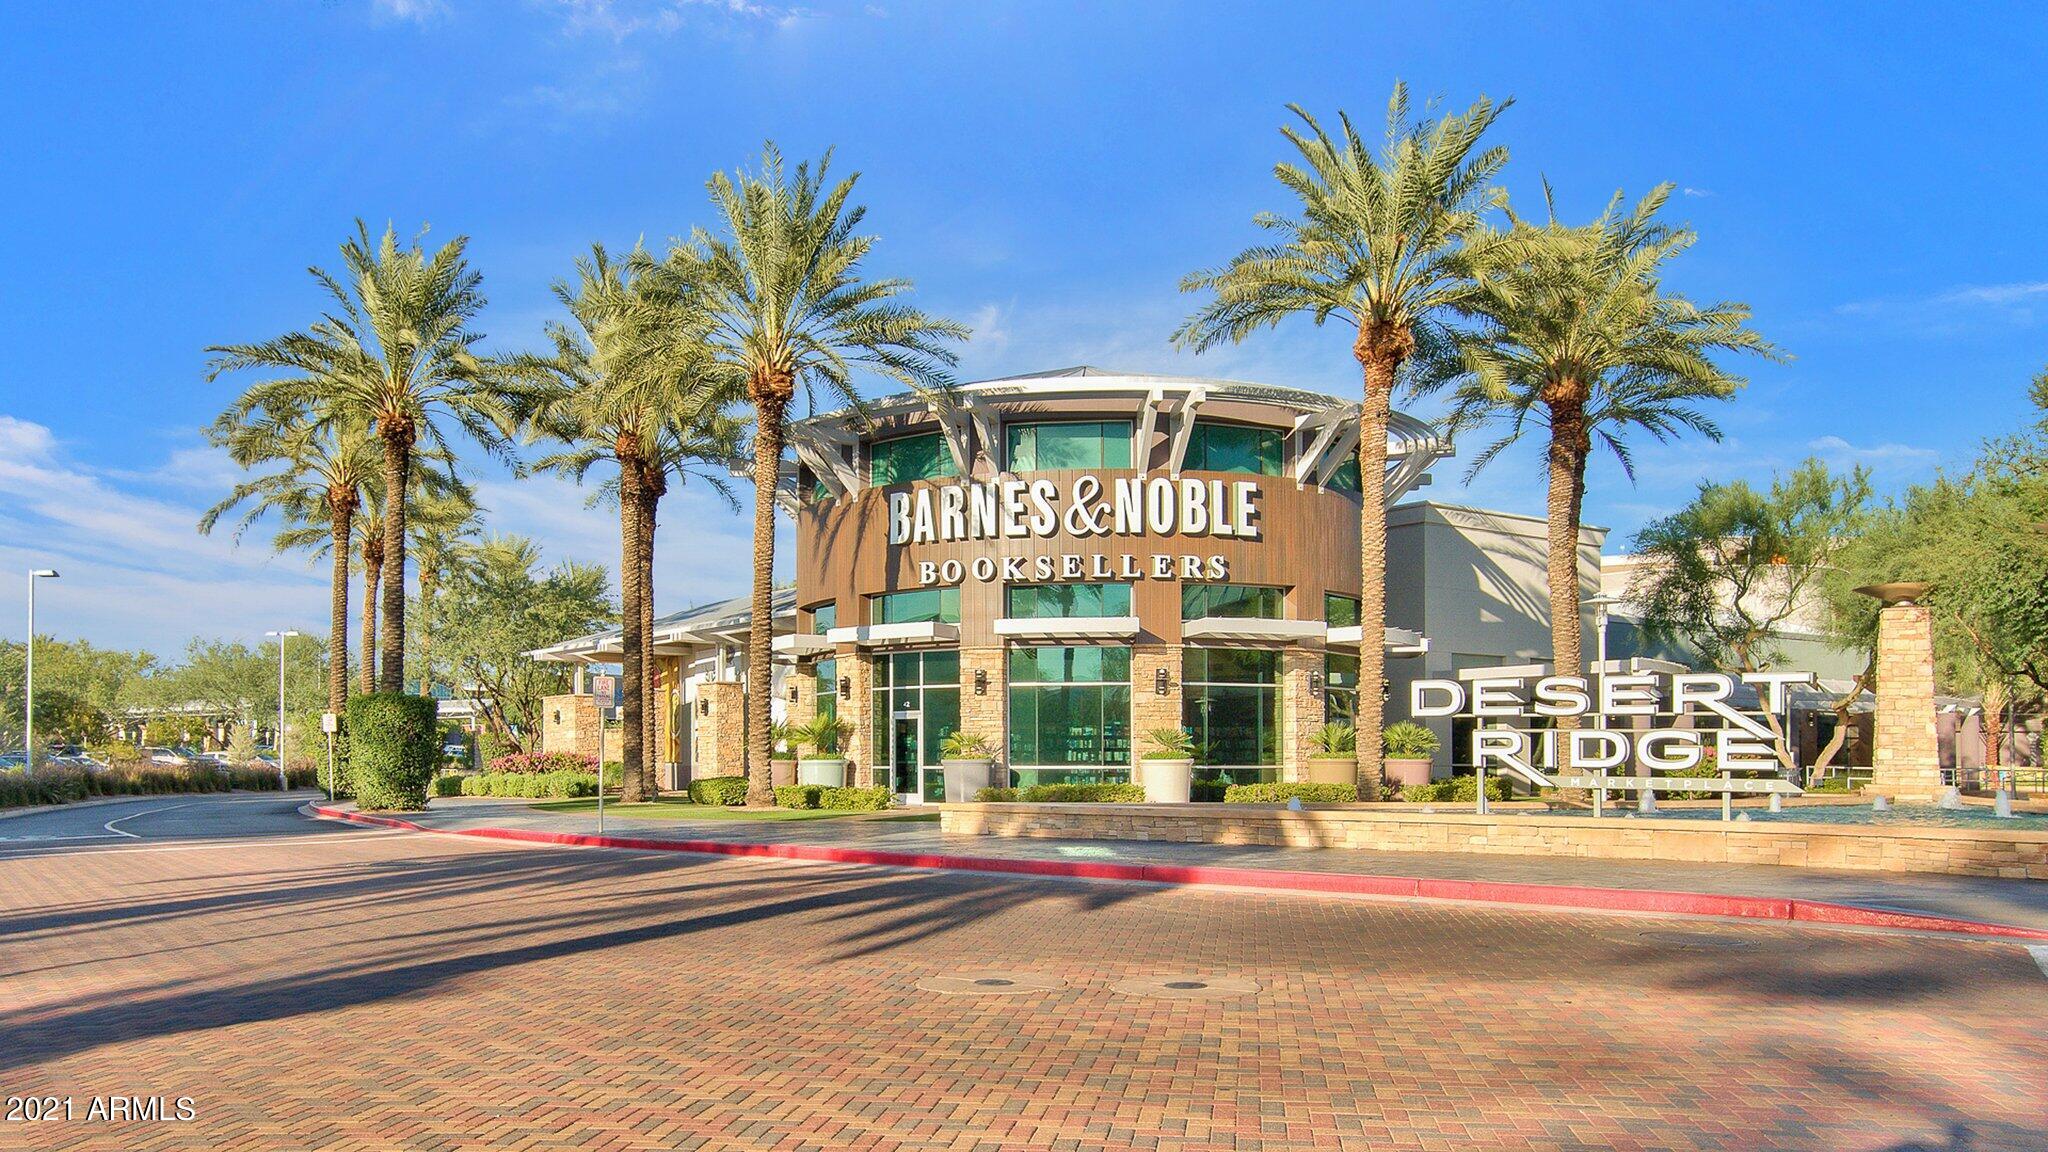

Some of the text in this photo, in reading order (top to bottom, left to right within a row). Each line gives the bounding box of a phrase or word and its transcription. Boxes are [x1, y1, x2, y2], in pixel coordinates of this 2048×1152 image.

[918, 555, 1230, 585] BOOKSELLERS
[1410, 672, 1815, 739] DESERT
[1471, 729, 1781, 788] RIDGE
[1570, 778, 1776, 791] MARKETPLACE
